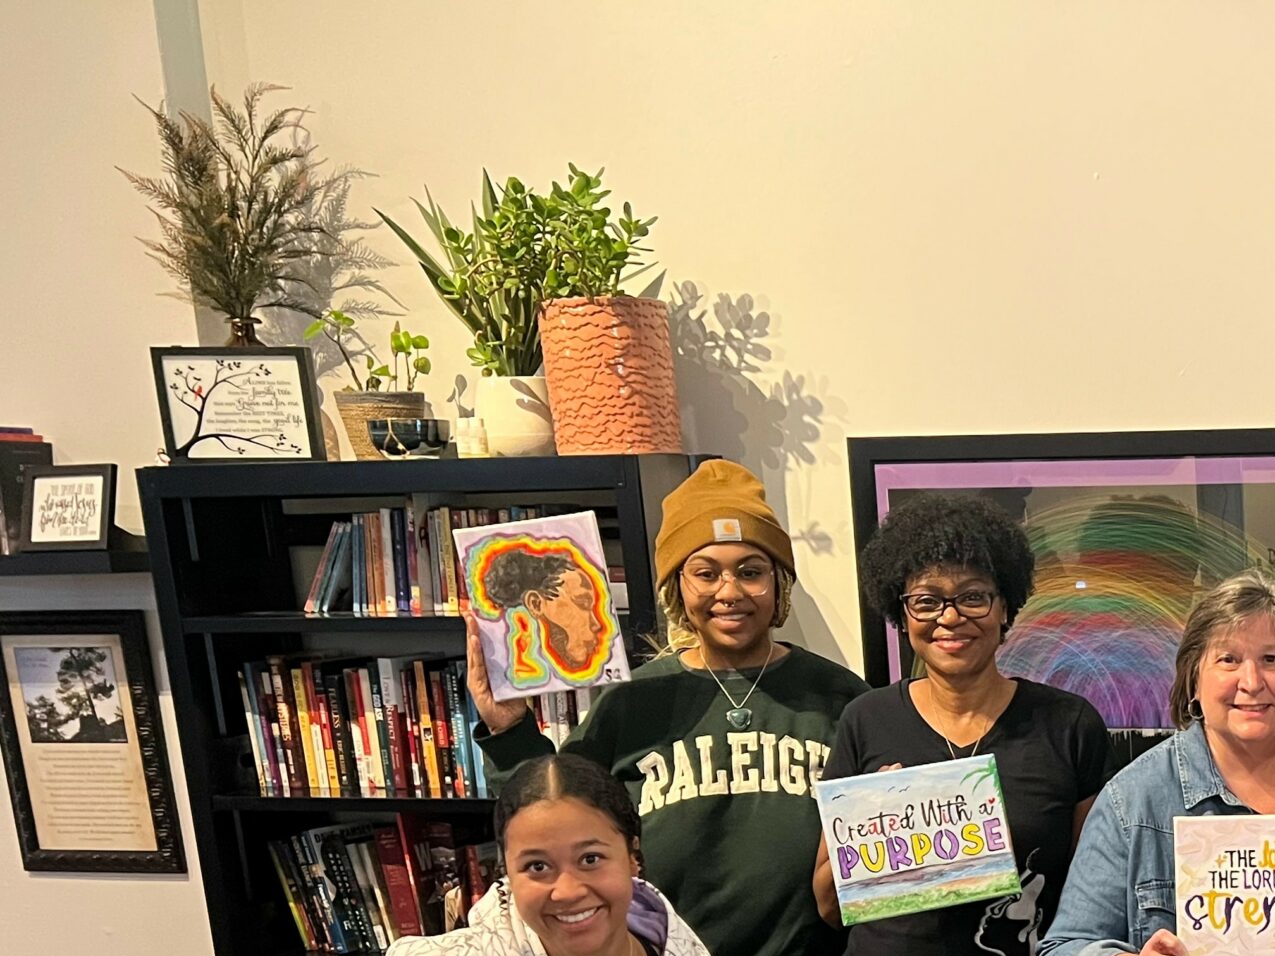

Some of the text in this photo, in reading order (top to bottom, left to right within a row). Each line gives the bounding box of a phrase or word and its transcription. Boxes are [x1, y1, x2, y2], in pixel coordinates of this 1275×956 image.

[278, 702, 292, 741] MYSTERIES
[327, 688, 341, 729] FEARLESS
[386, 705, 396, 741] RESPECT
[832, 794, 994, 846] Created With a
[836, 817, 1006, 880] PURPOSE
[1225, 850, 1257, 868] THE
[1208, 869, 1239, 889] THE
